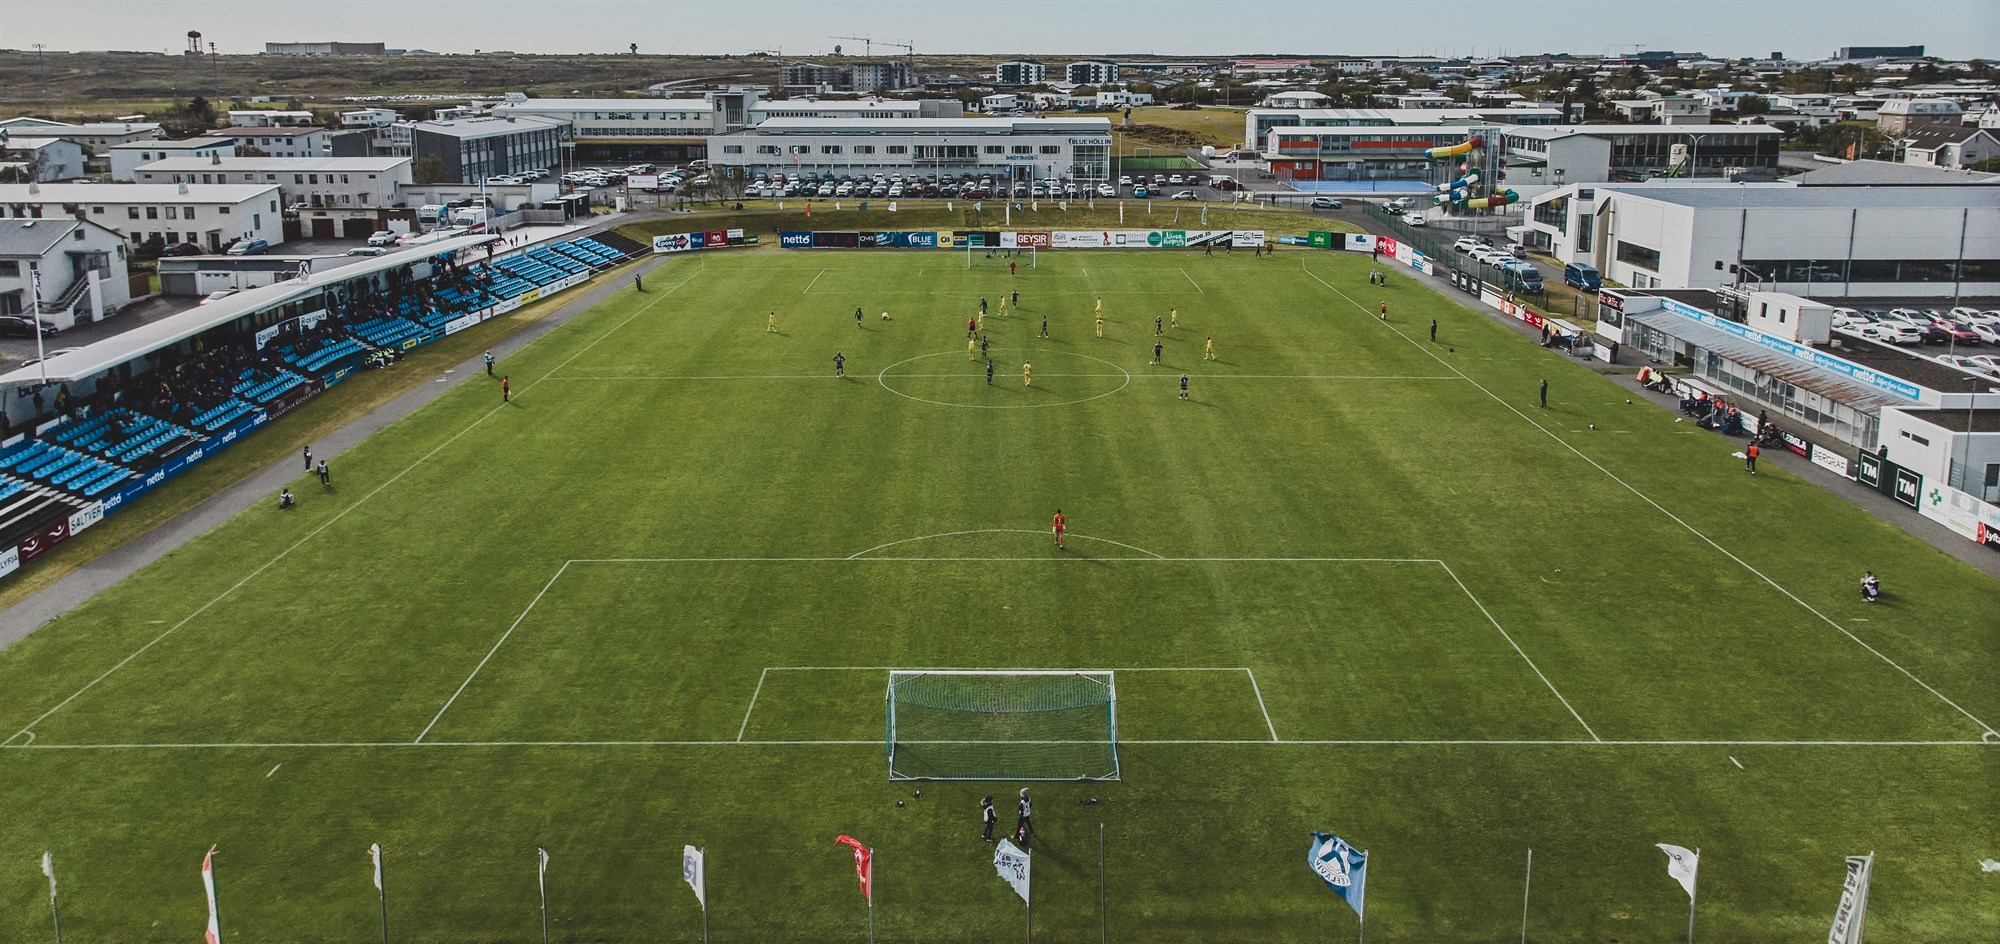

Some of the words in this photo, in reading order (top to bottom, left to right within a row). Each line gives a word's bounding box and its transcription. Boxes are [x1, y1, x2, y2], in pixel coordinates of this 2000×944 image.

[783, 235, 810, 244] nettó
[1017, 234, 1047, 243] GEYSIR
[1701, 315, 1717, 327] nettó
[1745, 330, 1762, 343] nettó
[1795, 348, 1815, 362] nettó
[1853, 368, 1876, 383] nettó
[253, 412, 268, 426] nettó
[222, 429, 237, 444] nettó
[186, 448, 203, 464] nettó
[146, 469, 165, 486] nettó
[1863, 462, 1877, 479] TM
[1898, 478, 1916, 498] TM
[102, 493, 122, 511] nettó
[70, 505, 102, 532] SALTVER
